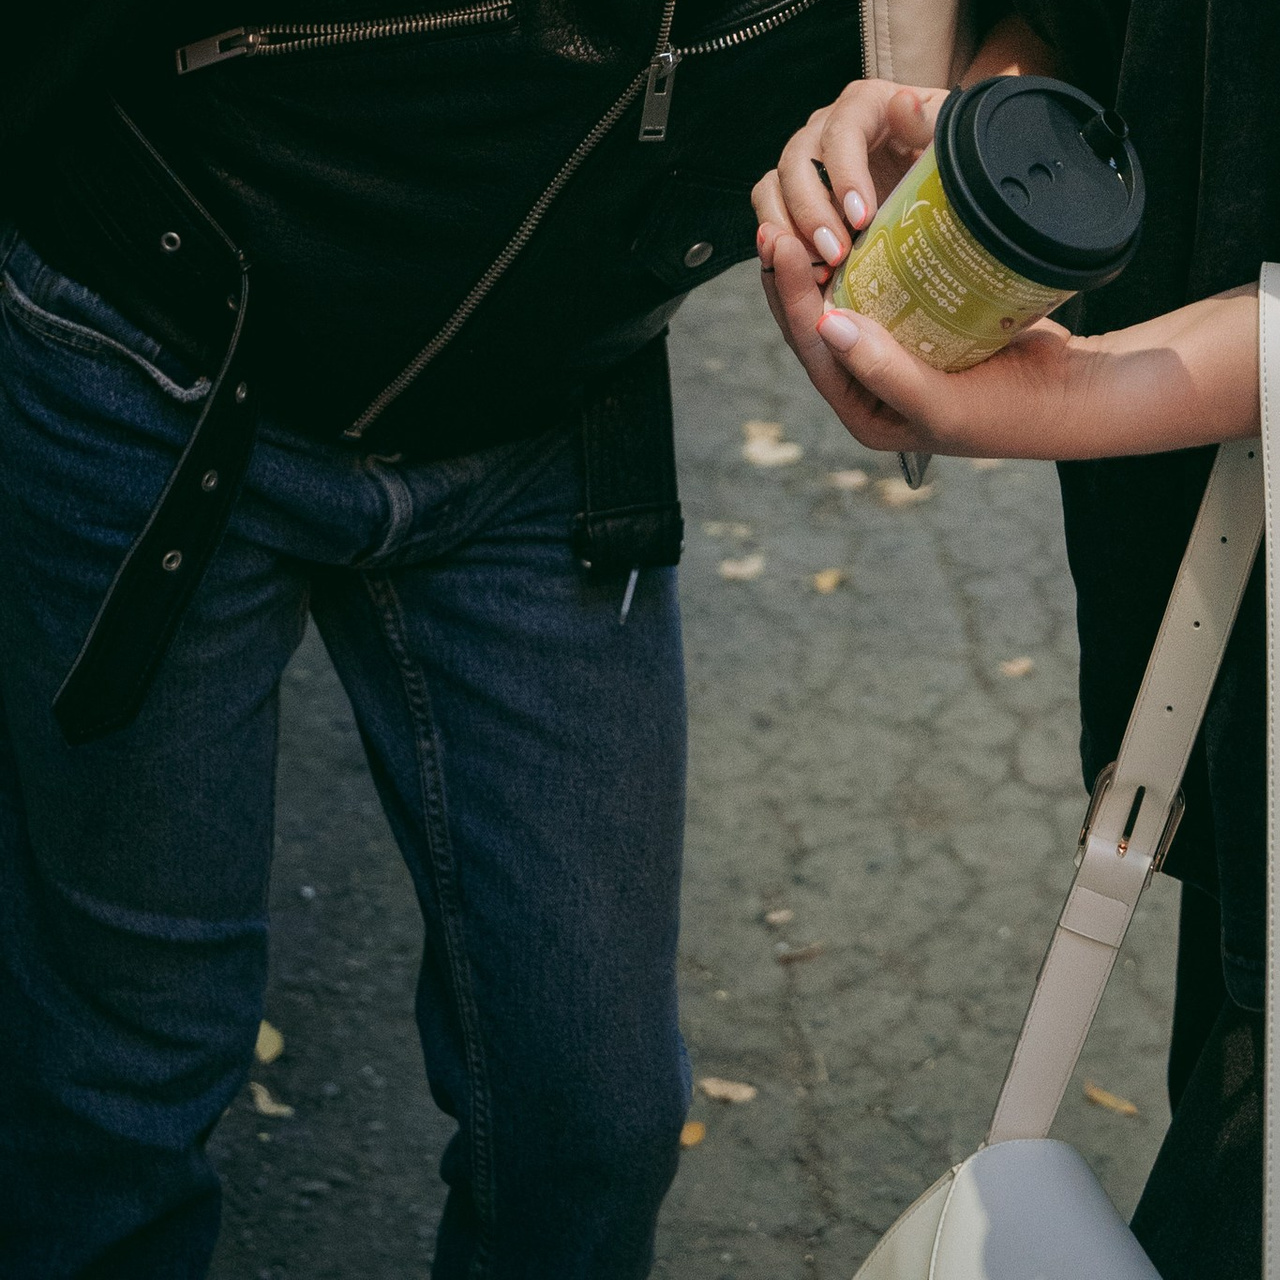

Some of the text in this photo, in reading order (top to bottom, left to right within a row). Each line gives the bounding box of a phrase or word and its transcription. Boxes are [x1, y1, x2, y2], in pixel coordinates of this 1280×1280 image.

[907, 235, 915, 247] в
[913, 248, 965, 306] подарок
[915, 227, 968, 295] получите
[942, 209, 995, 273] совершите
[900, 242, 957, 314] 5-ый кофе
